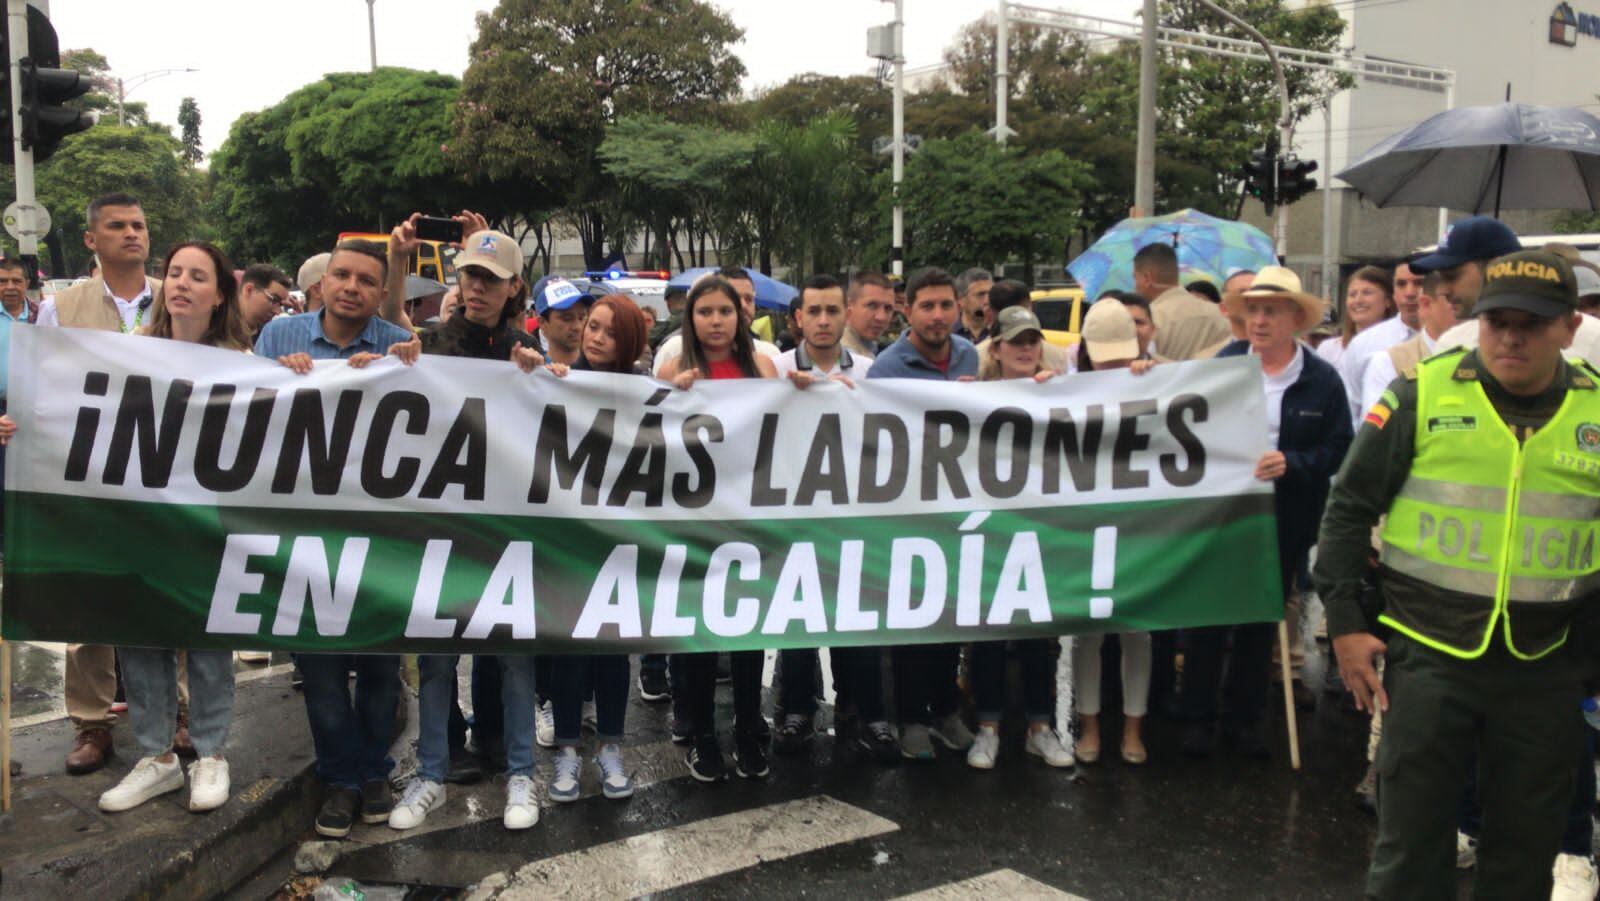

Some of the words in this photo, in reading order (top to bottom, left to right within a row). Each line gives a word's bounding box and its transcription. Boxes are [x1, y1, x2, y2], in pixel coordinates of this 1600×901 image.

[1486, 260, 1561, 283] POLICIA
[65, 371, 488, 502] ¡NUNCA
[527, 388, 724, 508] MÁS
[750, 394, 1209, 507] LADRONES
[205, 533, 370, 637] EN
[404, 538, 536, 640] LA
[571, 511, 1053, 640] ALCALDÍA
[1089, 526, 1117, 619] !
